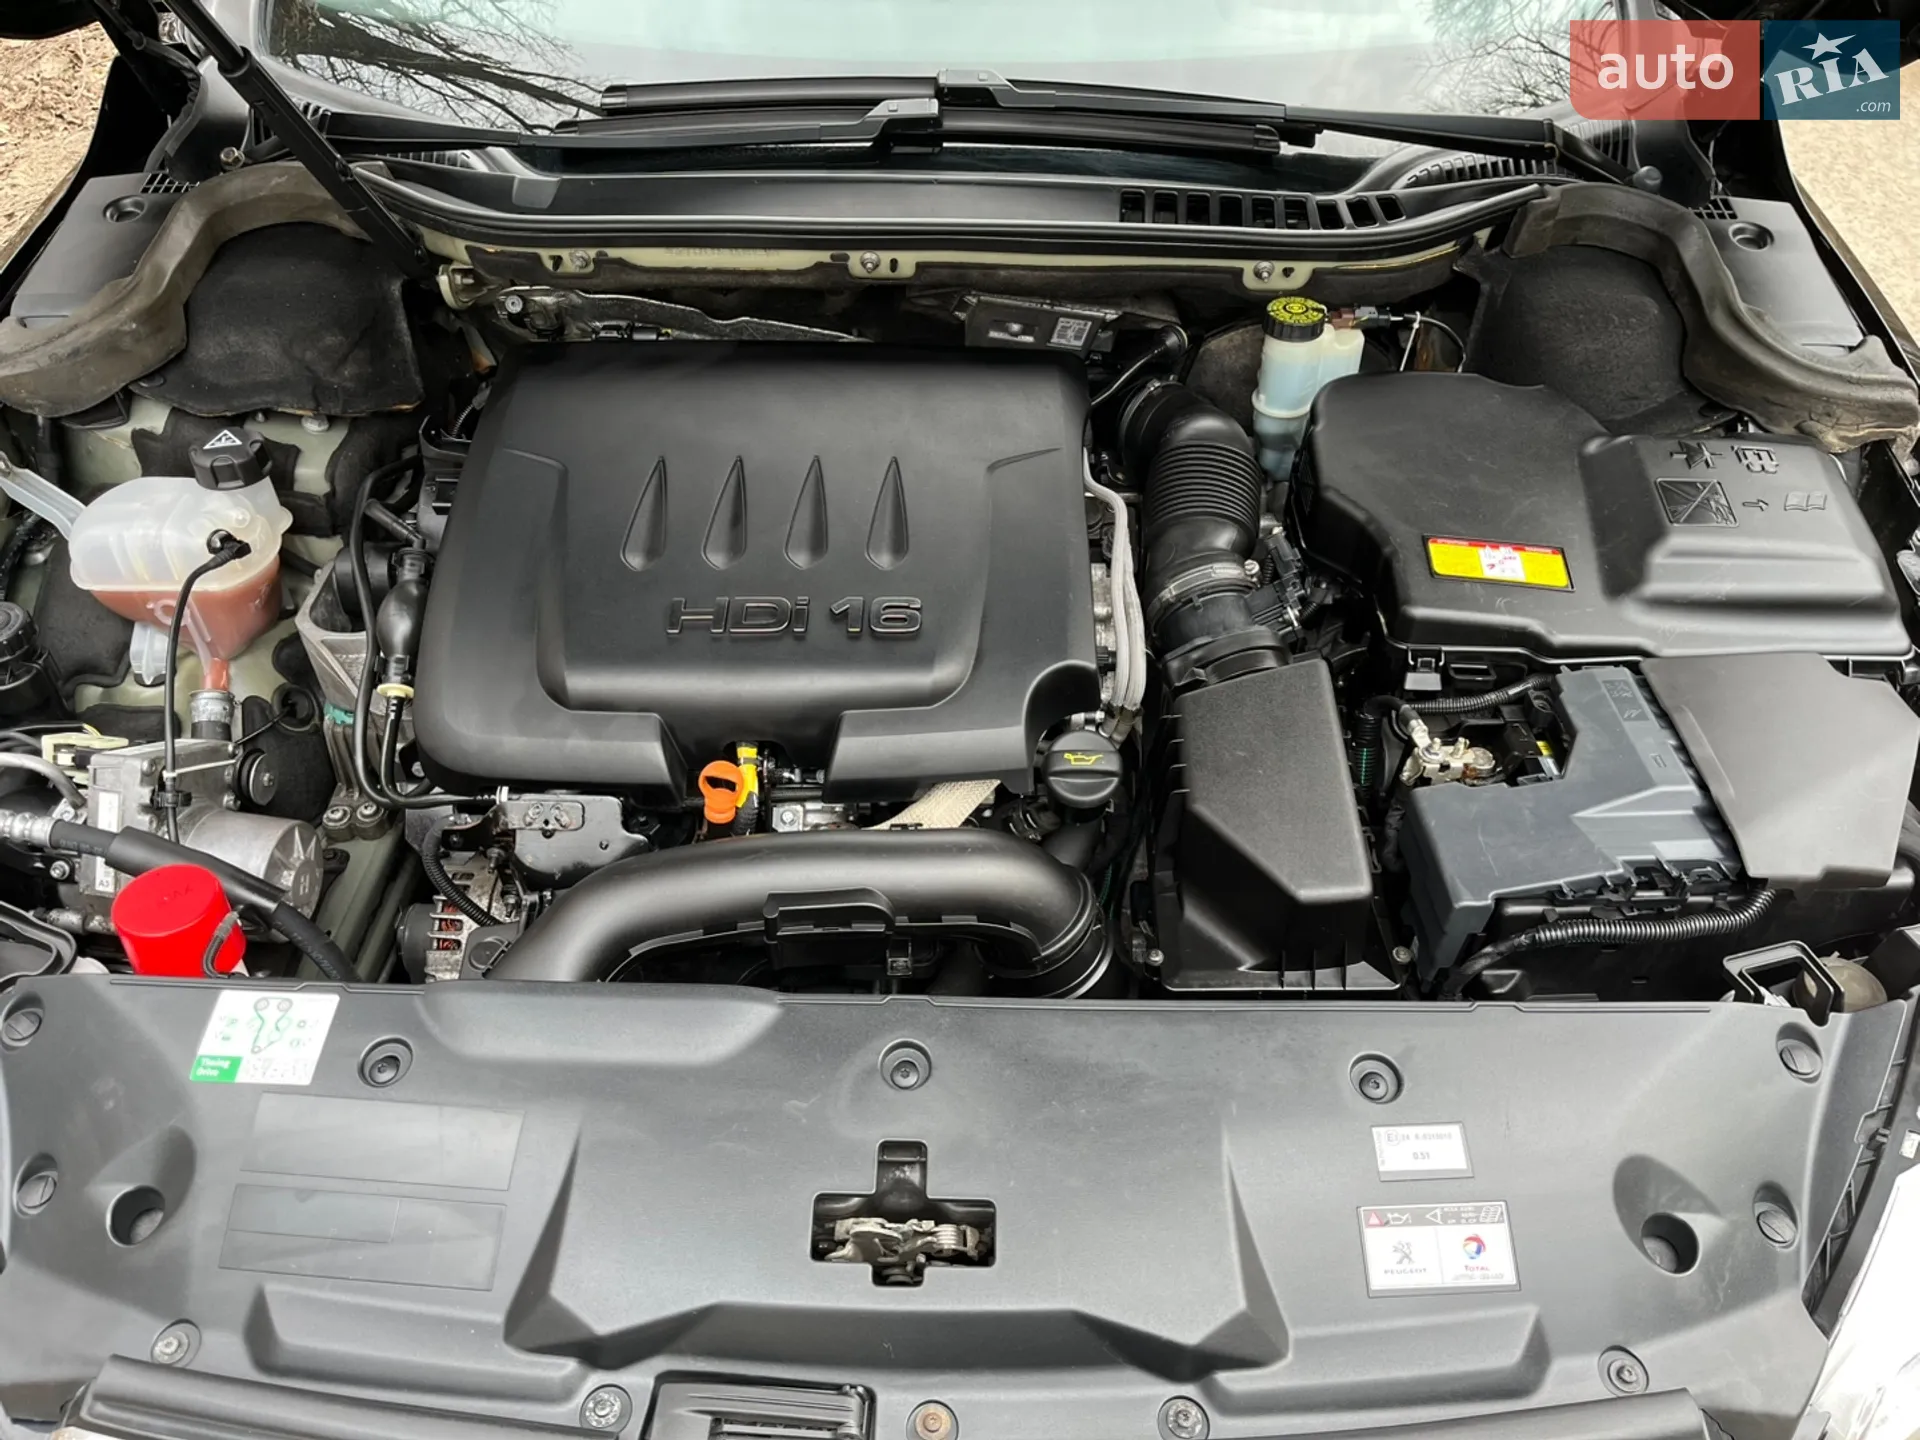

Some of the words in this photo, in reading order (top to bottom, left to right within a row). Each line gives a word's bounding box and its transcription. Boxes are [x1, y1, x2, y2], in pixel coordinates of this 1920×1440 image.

[666, 596, 810, 634] HDi
[829, 596, 923, 634] 16
[1384, 1267, 1427, 1275] PEUGEOT
[1464, 1264, 1490, 1272] TOTAL
